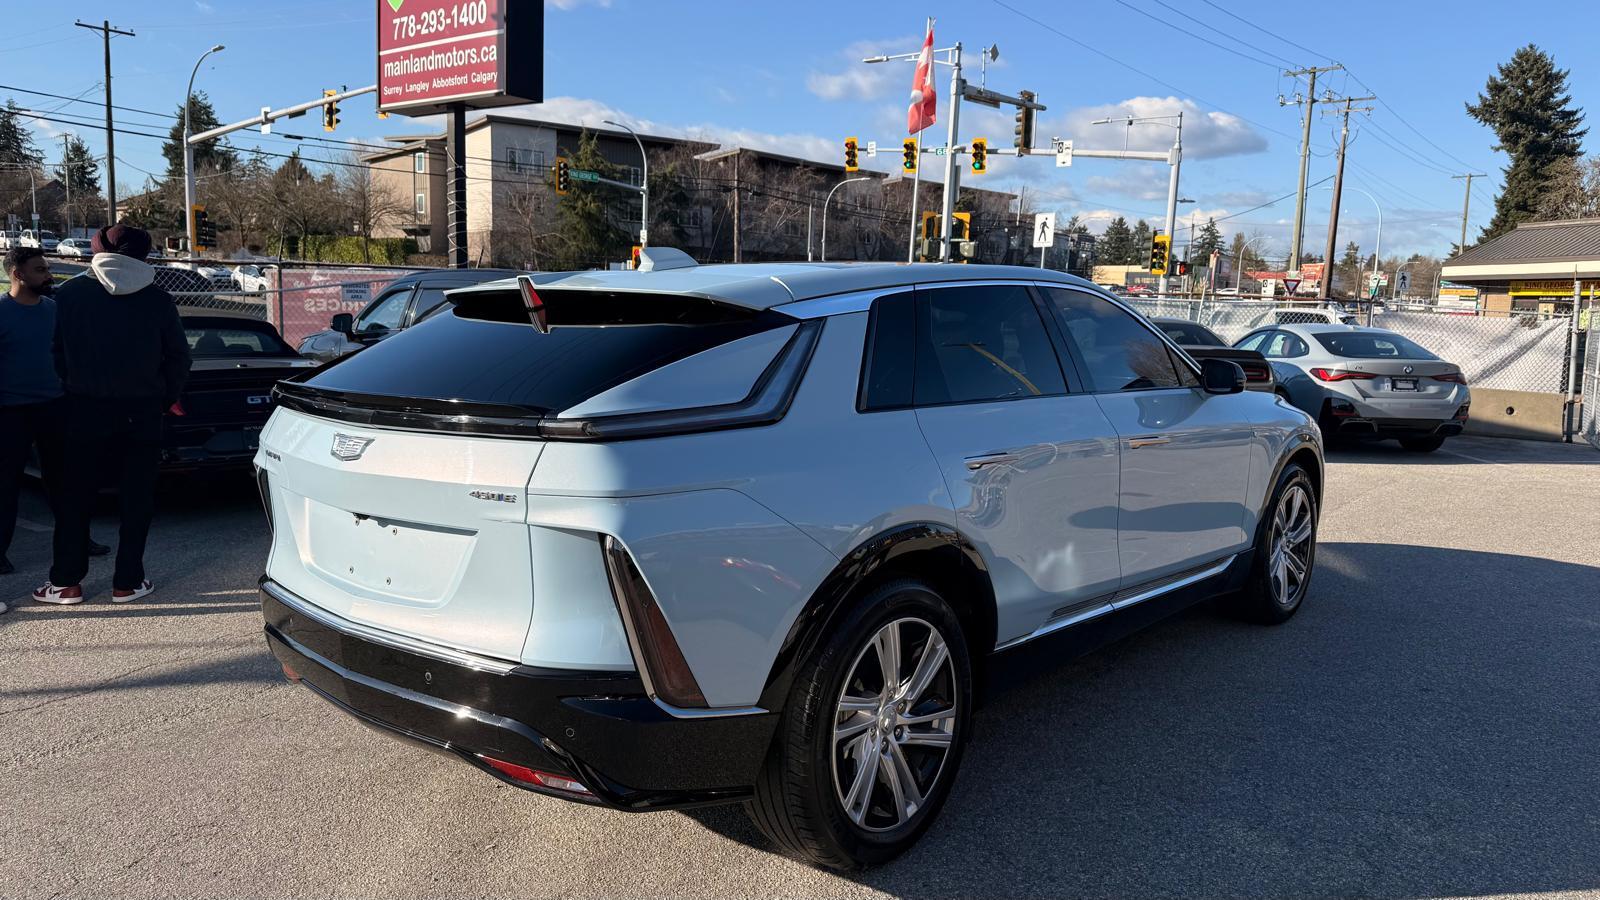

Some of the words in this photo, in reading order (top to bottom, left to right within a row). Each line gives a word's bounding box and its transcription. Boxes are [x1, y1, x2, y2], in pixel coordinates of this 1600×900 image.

[393, 1, 487, 40] 778-293-1400
[384, 45, 497, 77] mainlandmotors.ca
[383, 85, 403, 95] Surrey
[405, 81, 430, 93] Langley
[432, 74, 468, 88] Abbotsford
[471, 71, 498, 83] Calgary
